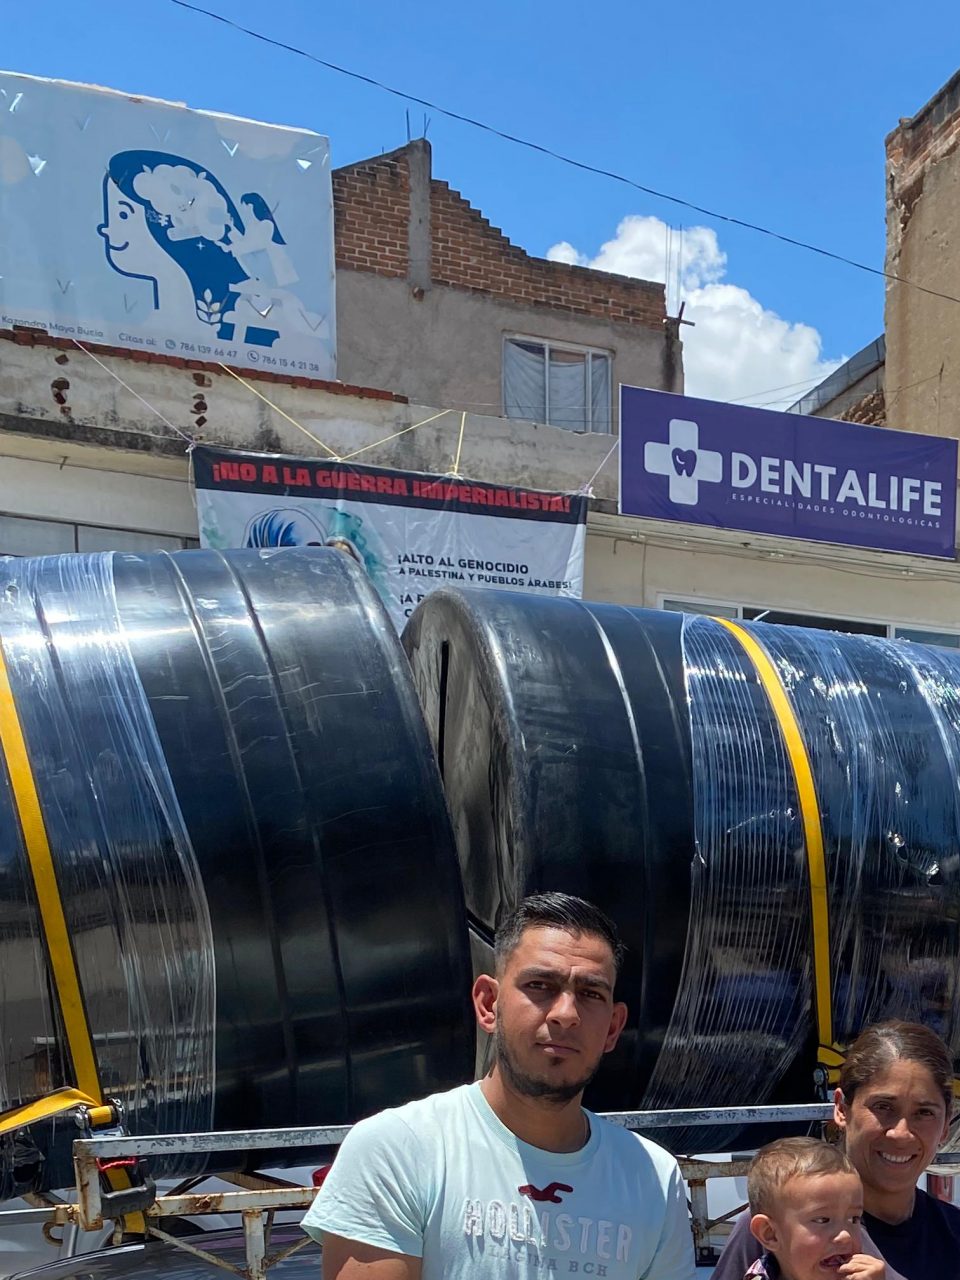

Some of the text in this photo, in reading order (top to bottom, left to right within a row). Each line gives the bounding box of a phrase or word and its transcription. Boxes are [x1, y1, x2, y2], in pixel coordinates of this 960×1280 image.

[118, 331, 143, 345] Citas
[180, 342, 238, 359] 786 139 66 47
[263, 355, 319, 372] 786 15 4 21 38
[212, 461, 572, 514] ¡NO A LA GUERRA IMPERIALISTA!
[731, 451, 942, 517] DENTALIFE
[732, 493, 941, 529] ESPECIALIDADES ODONTOLOGICAS
[398, 554, 529, 575] ¡ALTO AL GENOCIDIO
[399, 567, 572, 590] A PALESTINA Y PUEBLOS ÁRABES!
[463, 1198, 633, 1263] HOLLISTER
[487, 1243, 608, 1277] LAGUNA BCH
